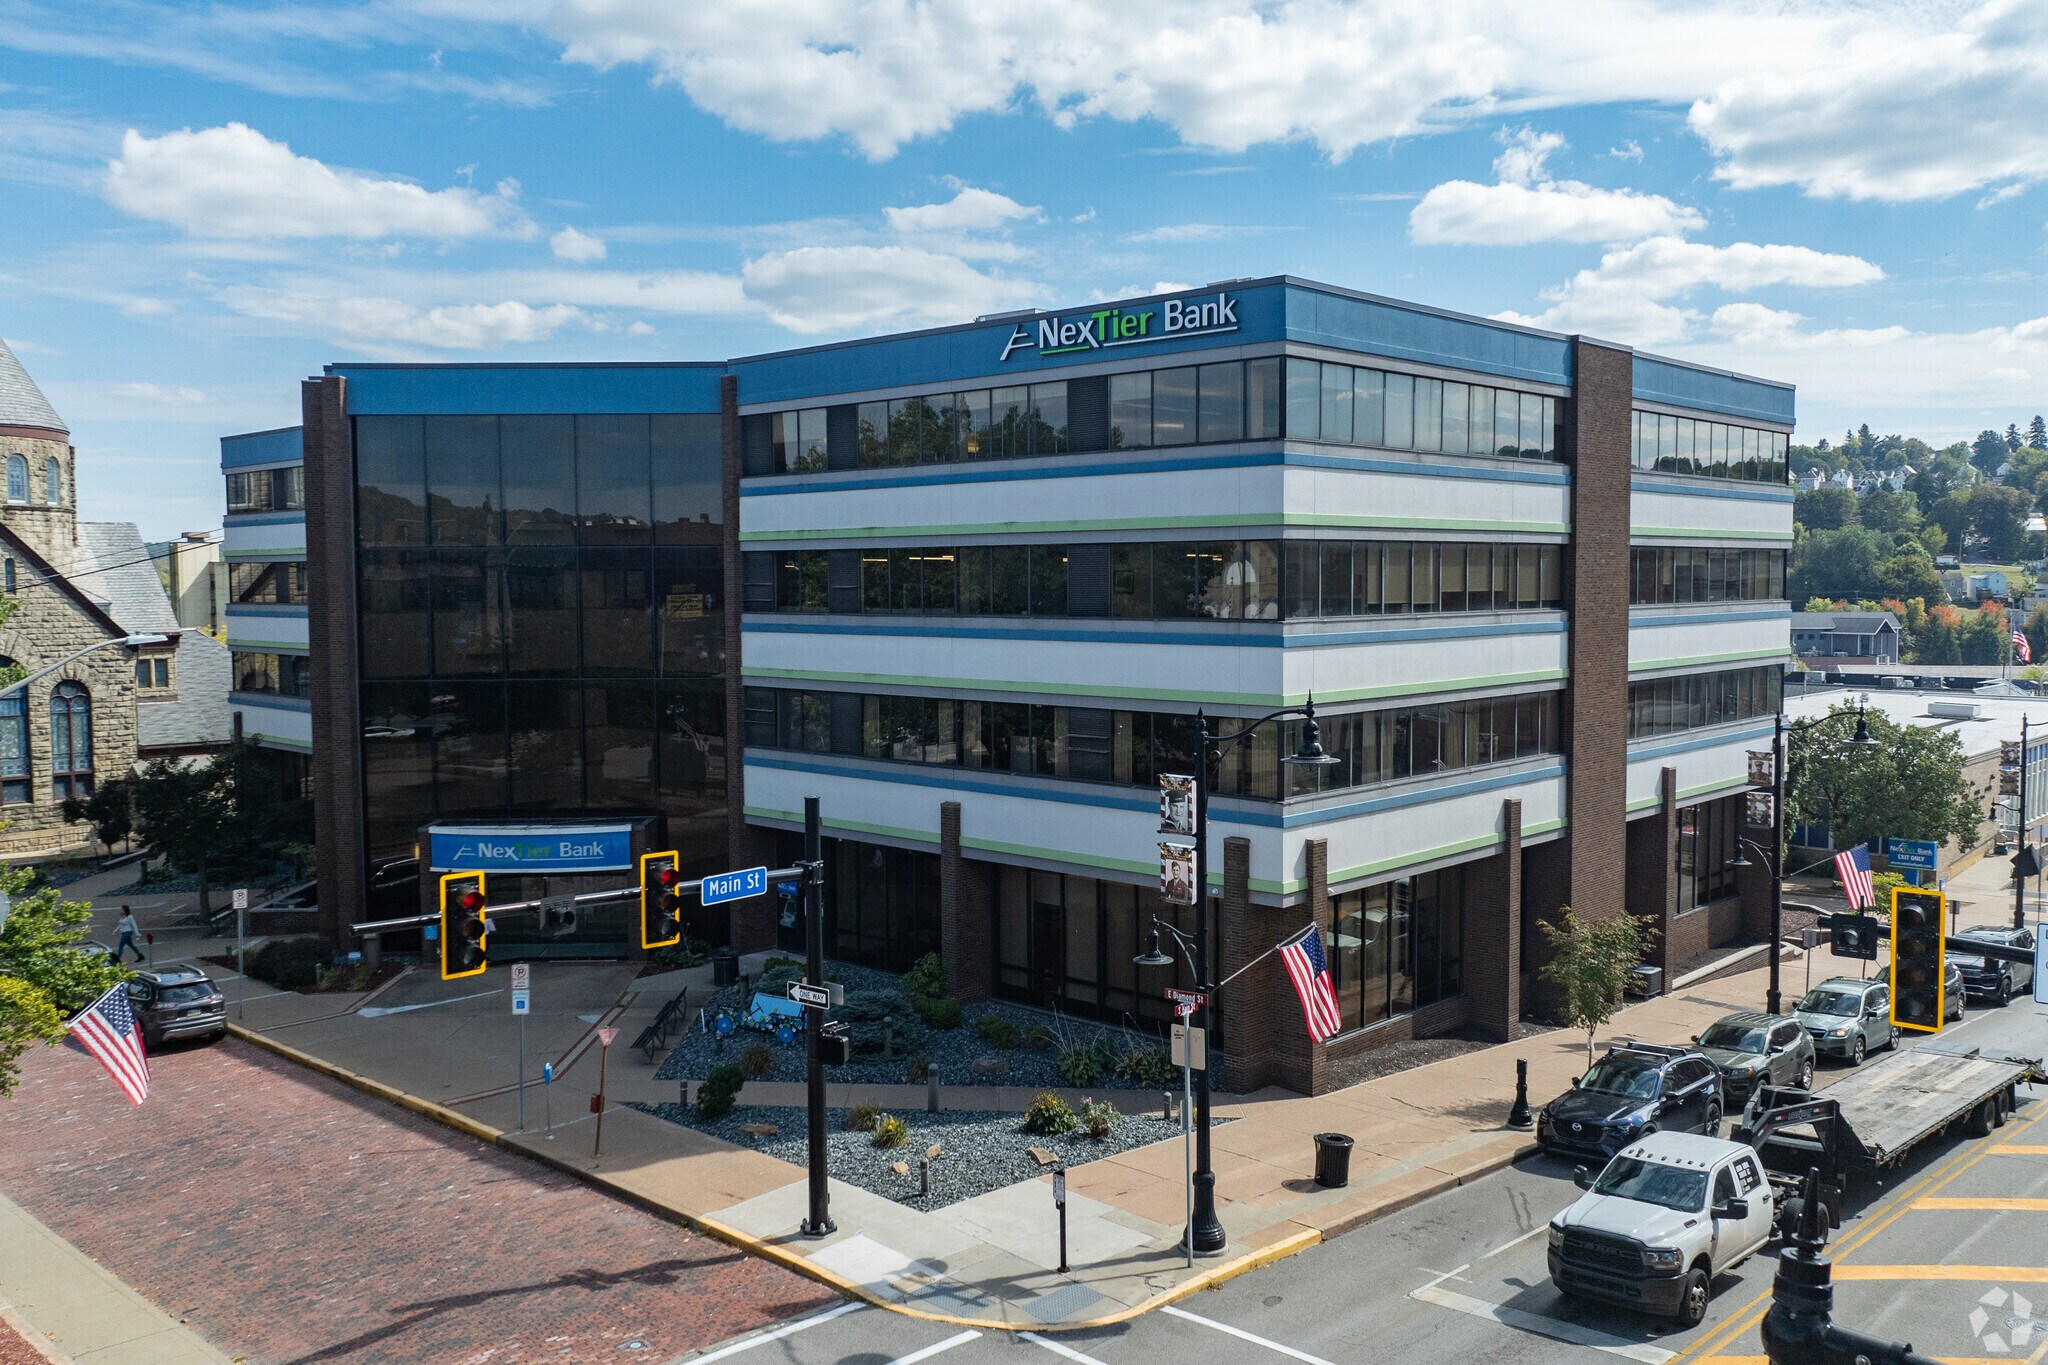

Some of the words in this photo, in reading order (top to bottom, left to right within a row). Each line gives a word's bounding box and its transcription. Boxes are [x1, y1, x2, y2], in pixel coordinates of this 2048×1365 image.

[1039, 310, 1154, 349] NexTier
[1164, 293, 1239, 332] Bank
[478, 842, 552, 861] NexTier
[560, 841, 605, 857] Bank
[1917, 848, 1933, 856] Bank
[709, 876, 741, 897] Main
[747, 872, 760, 889] St
[799, 989, 812, 999] ONE
[812, 993, 825, 1002] WAY
[1168, 990, 1172, 999] E
[1197, 994, 1204, 1004] St
